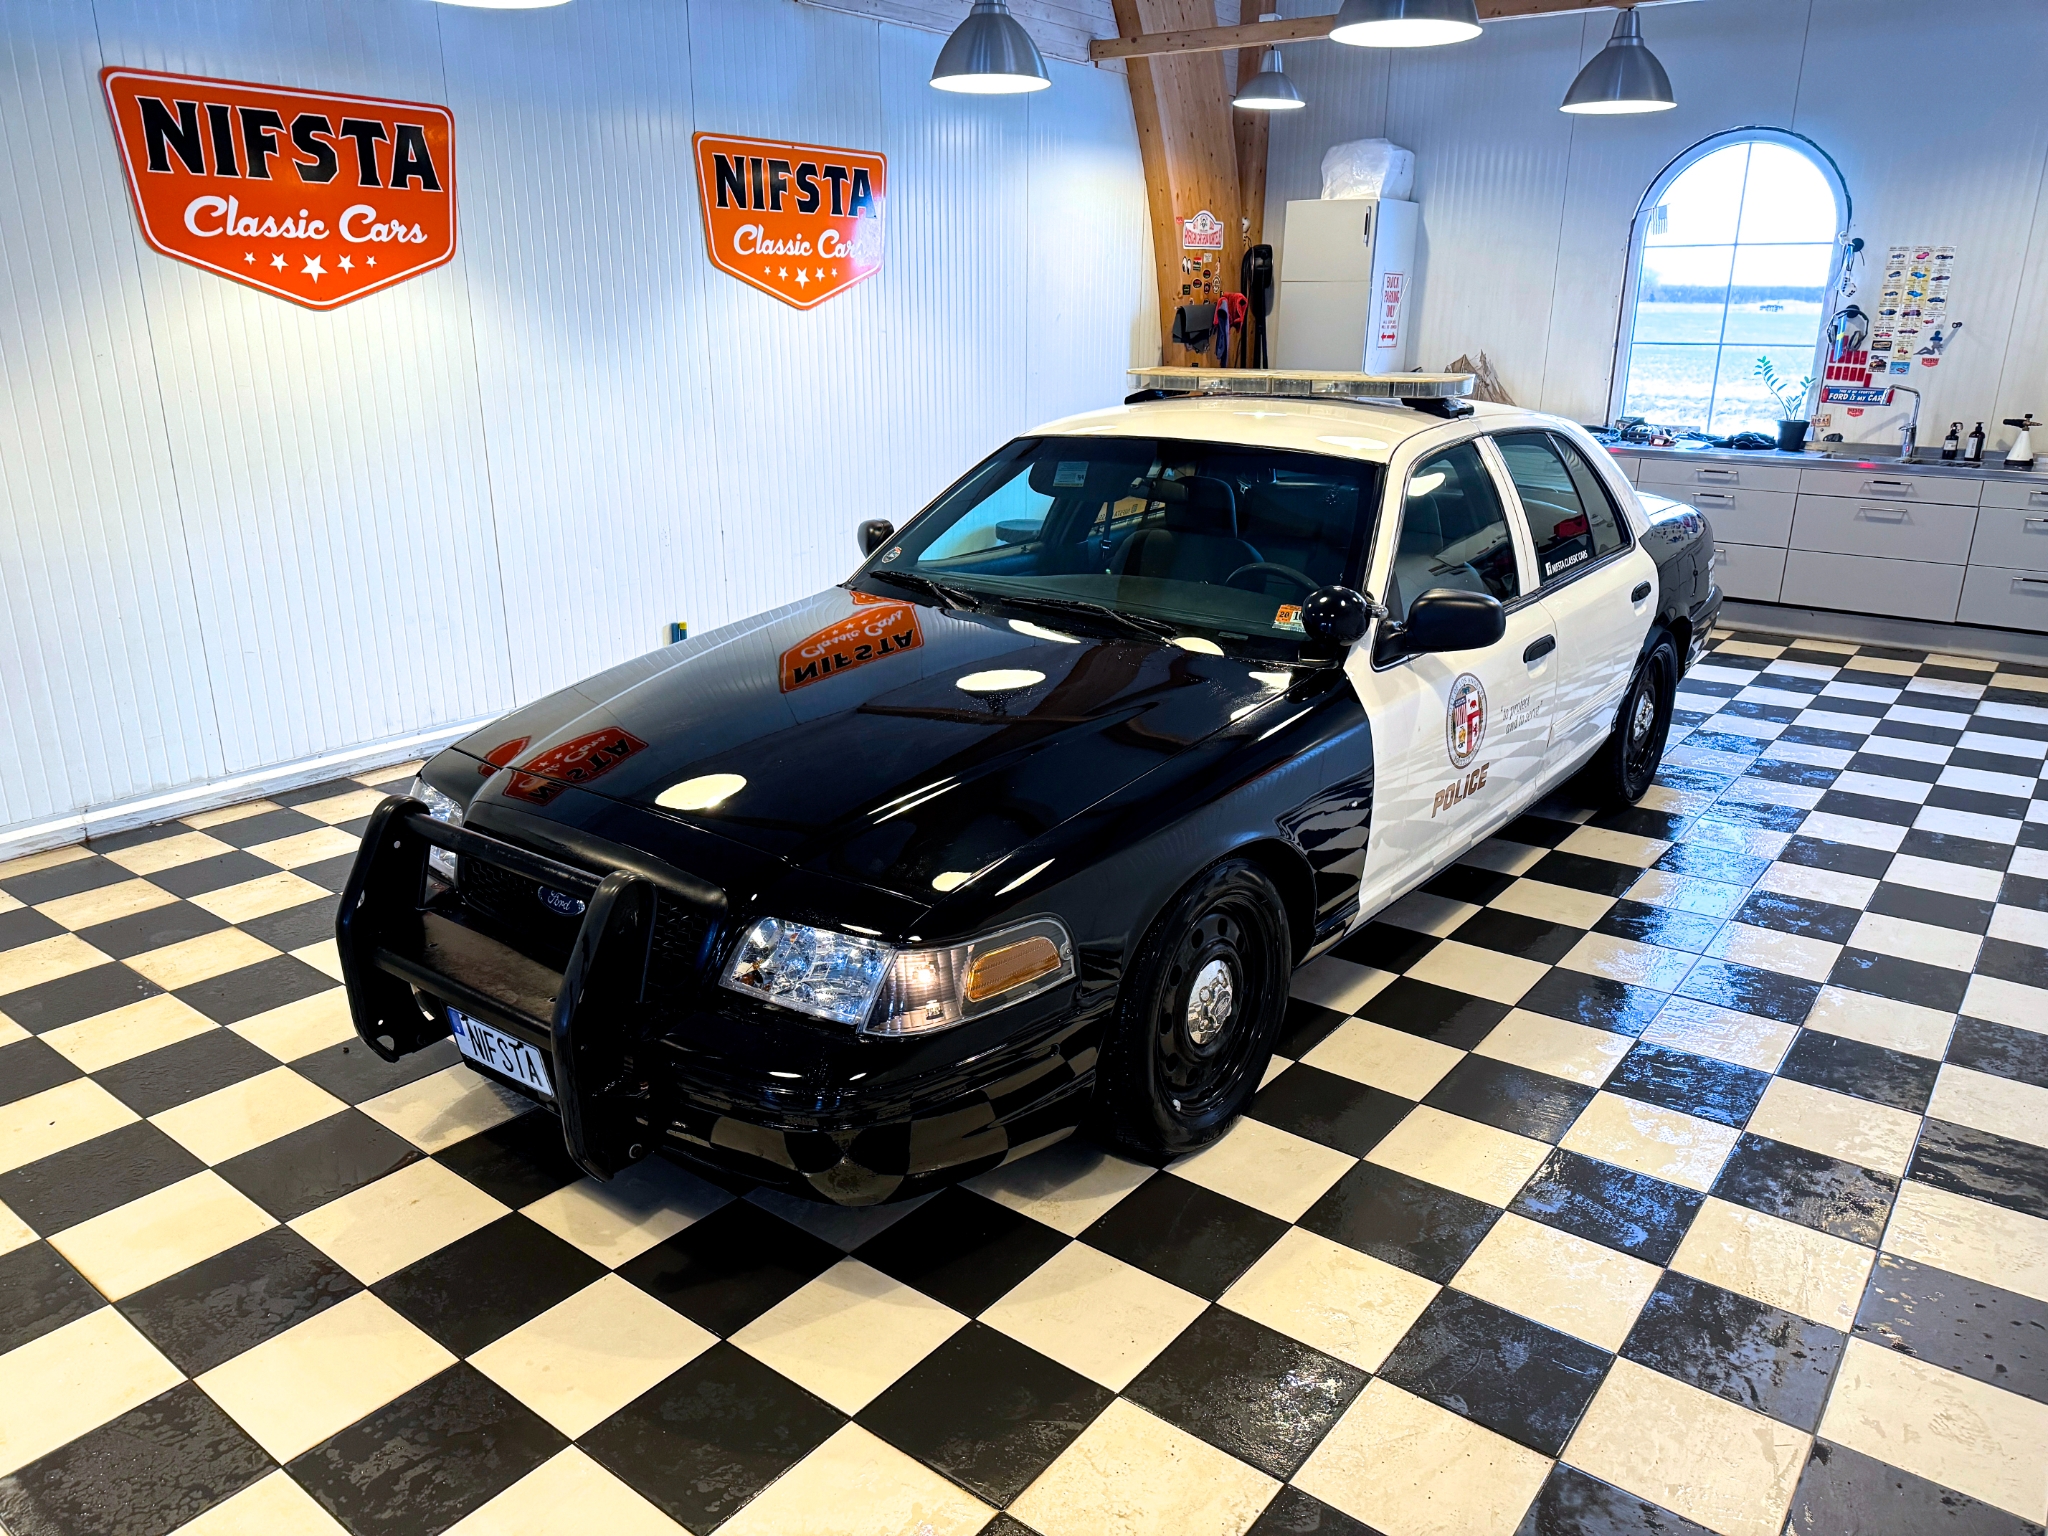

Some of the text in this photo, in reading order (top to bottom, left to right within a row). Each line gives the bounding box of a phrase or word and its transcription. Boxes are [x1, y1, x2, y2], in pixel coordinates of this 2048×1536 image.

[134, 95, 443, 192] NIFSTA
[712, 152, 877, 219] NIFSTA
[184, 194, 428, 243] Classic Cars
[733, 223, 813, 256] Classic
[1828, 393, 1848, 401] FORD
[1431, 762, 1489, 818] POLICE
[547, 889, 572, 911] Ford
[466, 1020, 543, 1088] NIFSTA
